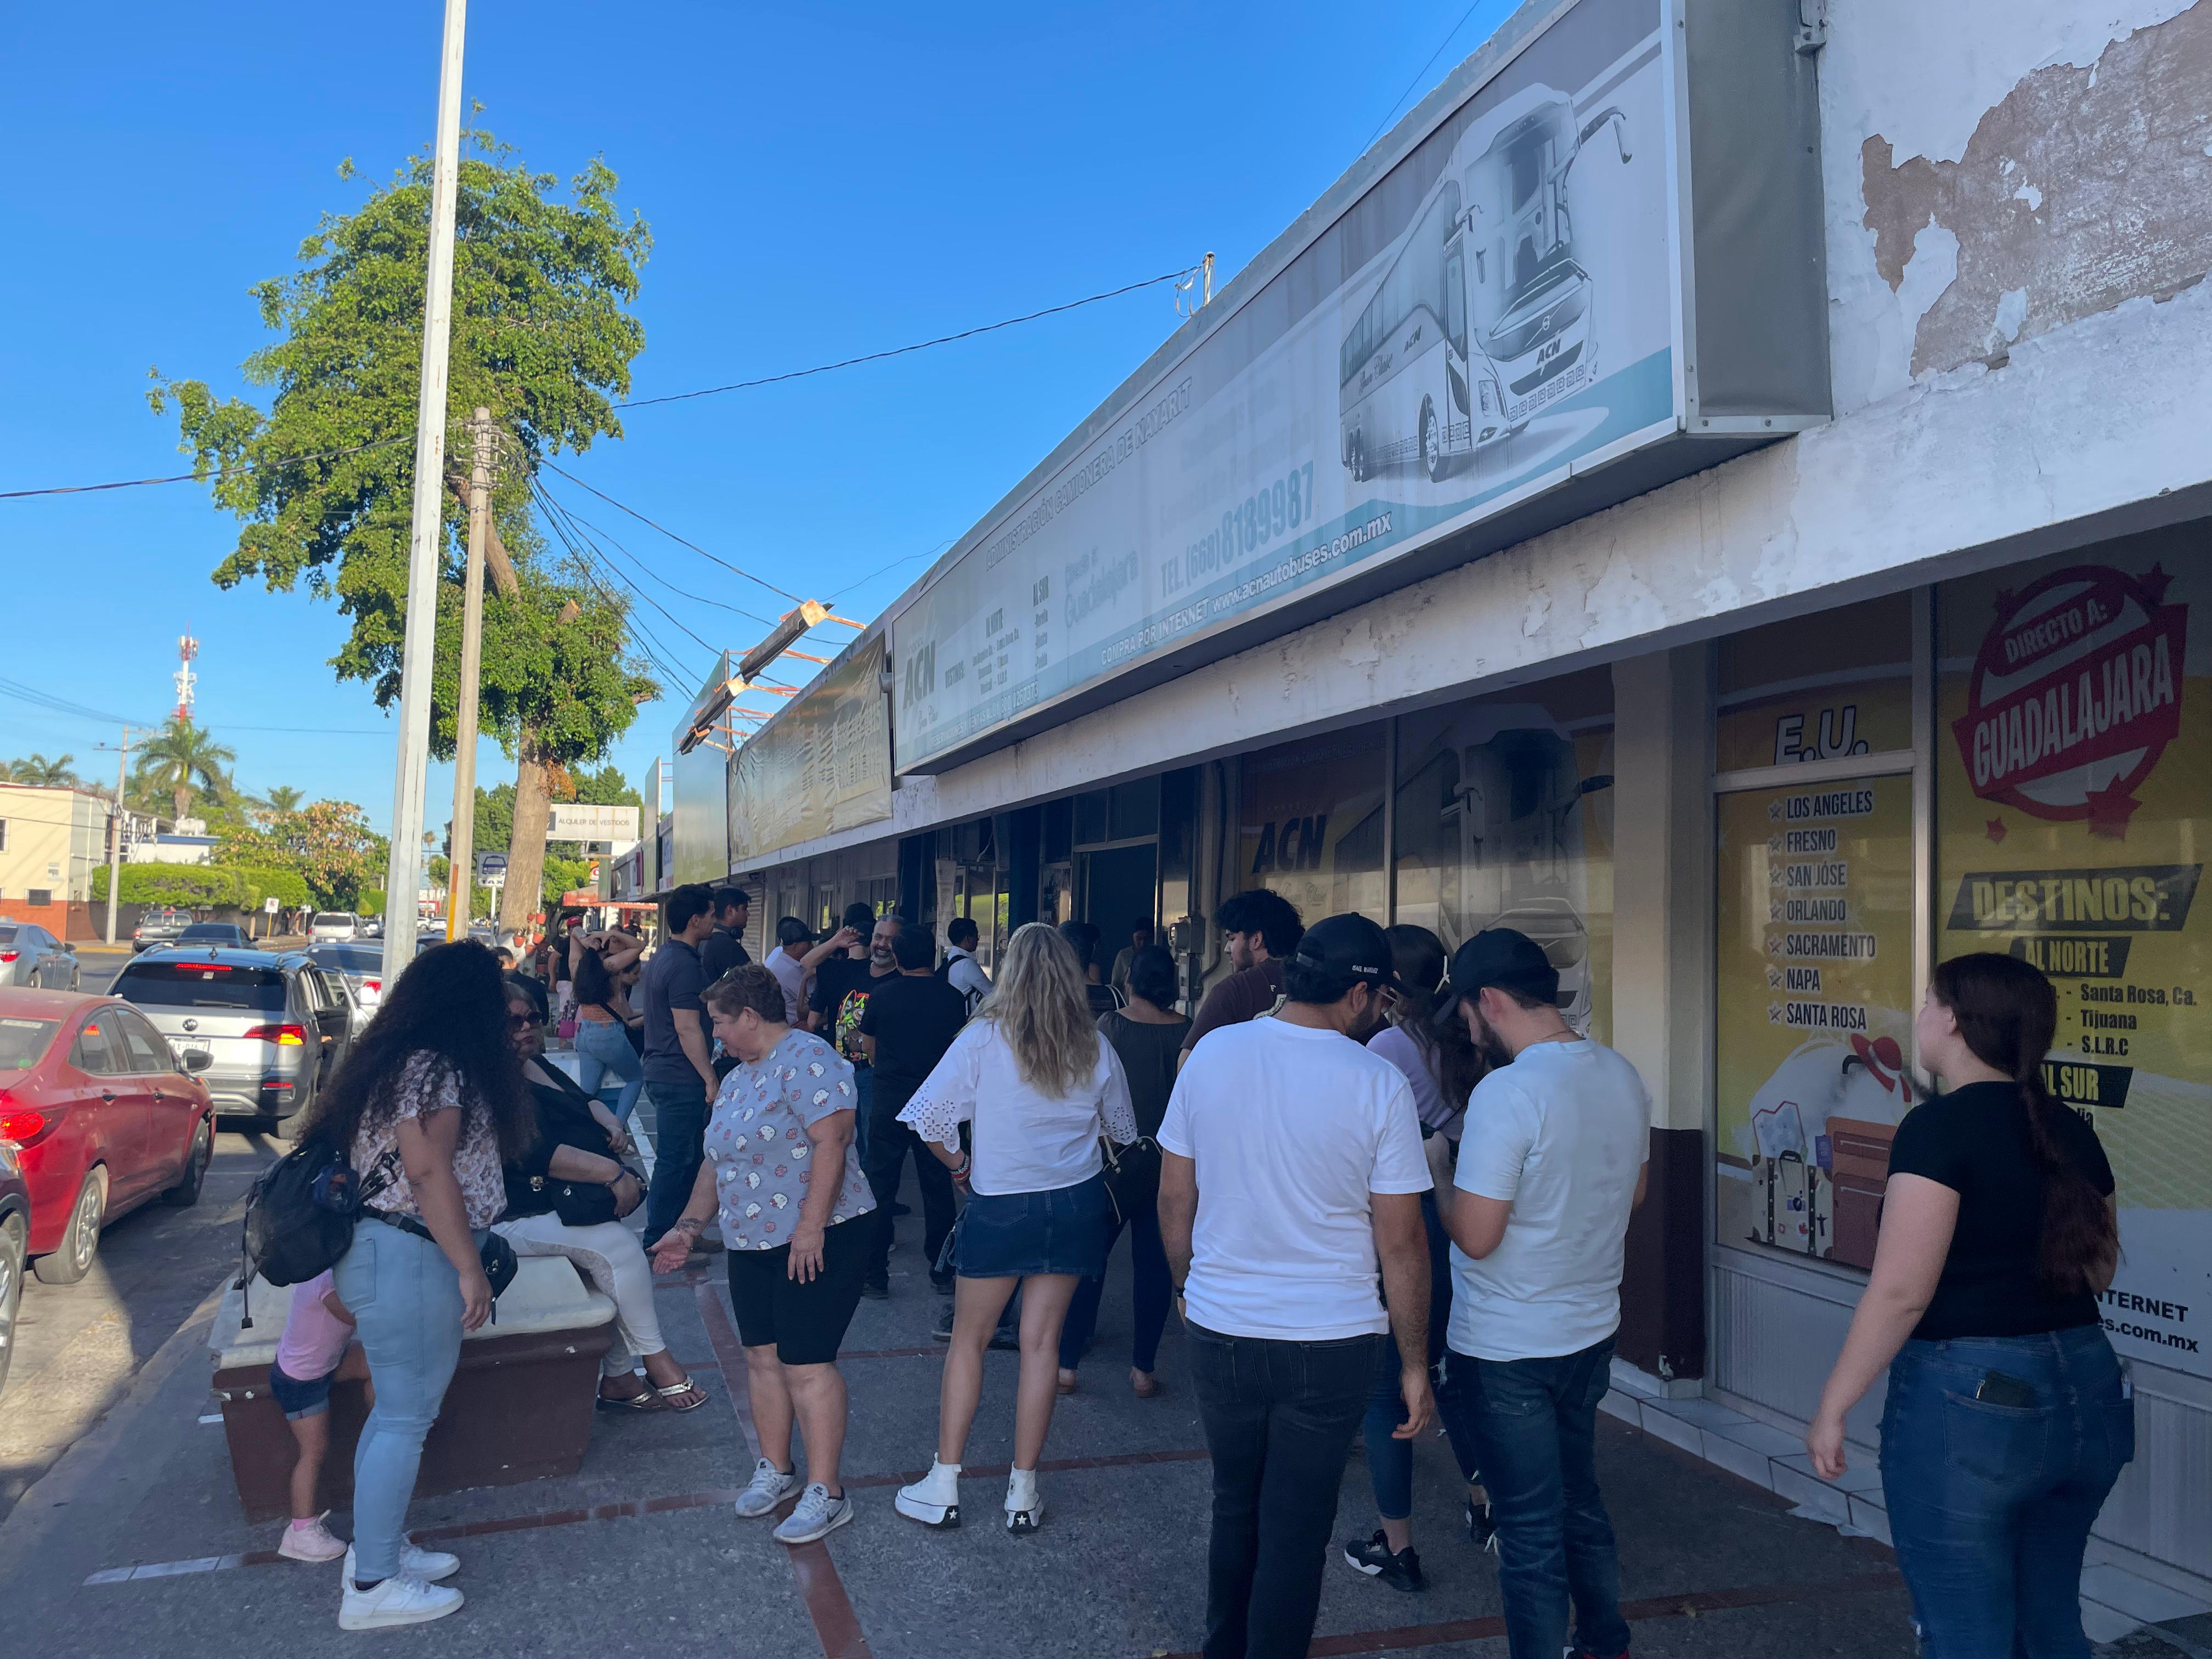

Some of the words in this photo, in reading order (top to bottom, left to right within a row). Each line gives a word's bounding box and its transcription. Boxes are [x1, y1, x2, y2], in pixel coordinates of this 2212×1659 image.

[1536, 338, 1561, 365] ACN
[986, 493, 1054, 572] ADMINISTRACIÓN
[1053, 444, 1115, 515] CAMIONERA
[1116, 428, 1134, 465] DE
[1134, 375, 1193, 450] NAYARIT
[1101, 635, 1137, 666] COMPRA
[1137, 624, 1158, 651] POR
[1158, 596, 1210, 641] INTERNET
[1211, 510, 1393, 614] www.acnautobuses.com.mx
[1161, 555, 1183, 599] TEL.
[2004, 608, 2085, 663] DIRECTO
[2087, 598, 2108, 627] A:
[903, 640, 936, 710] ACN
[1974, 633, 2174, 787] GUADALAJARA
[1774, 704, 1869, 765] E.U.
[1787, 797, 1810, 819] LOS
[1813, 791, 1872, 815] ANGELES
[1251, 814, 1327, 873] ACN
[1787, 829, 1836, 853] FRESNO
[1786, 865, 1812, 887] SAN
[1814, 860, 1846, 886] JÓSE
[1787, 900, 1846, 921] ORLANDO
[1972, 877, 2170, 922] DESTINOS:
[1786, 935, 1876, 957] SACRAMENTO
[2025, 940, 2045, 972] AL
[2050, 940, 2109, 974] NORTE
[1786, 968, 1821, 990] NAPA
[2081, 983, 2124, 1003] Santa
[2127, 985, 2169, 1007] Rosa,
[2172, 987, 2198, 1006] Ca.
[1786, 1003, 1828, 1025] SANTA
[1831, 1006, 1867, 1030] ROSA
[2081, 1009, 2137, 1030] Tijuana
[2081, 1035, 2129, 1056] S.L.R.C
[2059, 1065, 2100, 1102] SUR
